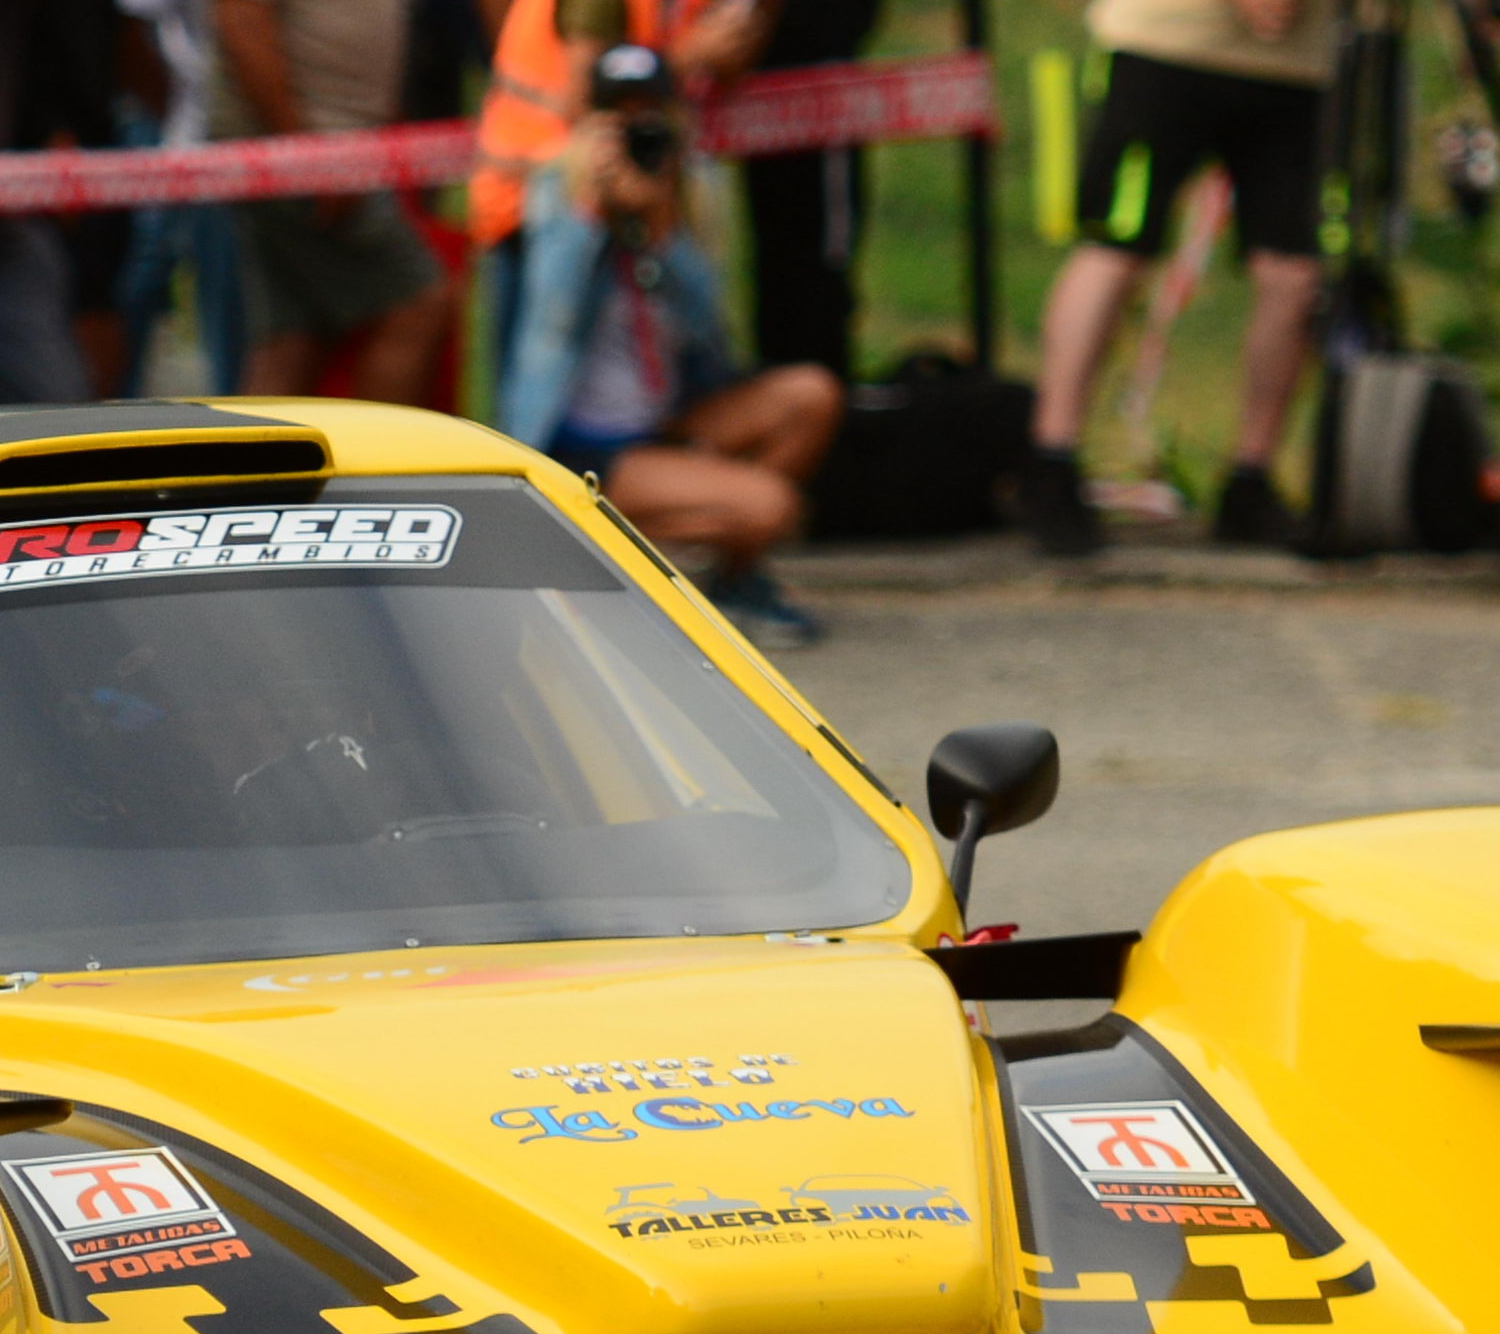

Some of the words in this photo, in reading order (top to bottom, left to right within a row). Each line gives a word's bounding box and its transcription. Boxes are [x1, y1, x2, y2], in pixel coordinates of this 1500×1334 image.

[510, 1055, 715, 1080] CUBITOS
[738, 1053, 800, 1066] DE
[562, 1067, 777, 1095] HIELO
[489, 1105, 639, 1144] La
[632, 1096, 916, 1131] Cueva
[608, 1206, 832, 1240] TALLERES
[852, 1205, 973, 1224] JUAN
[1101, 1202, 1272, 1229] TORCA
[687, 1231, 807, 1251] SEVARES
[829, 1225, 925, 1244] PILOÑA
[75, 1238, 252, 1285] TORCA
